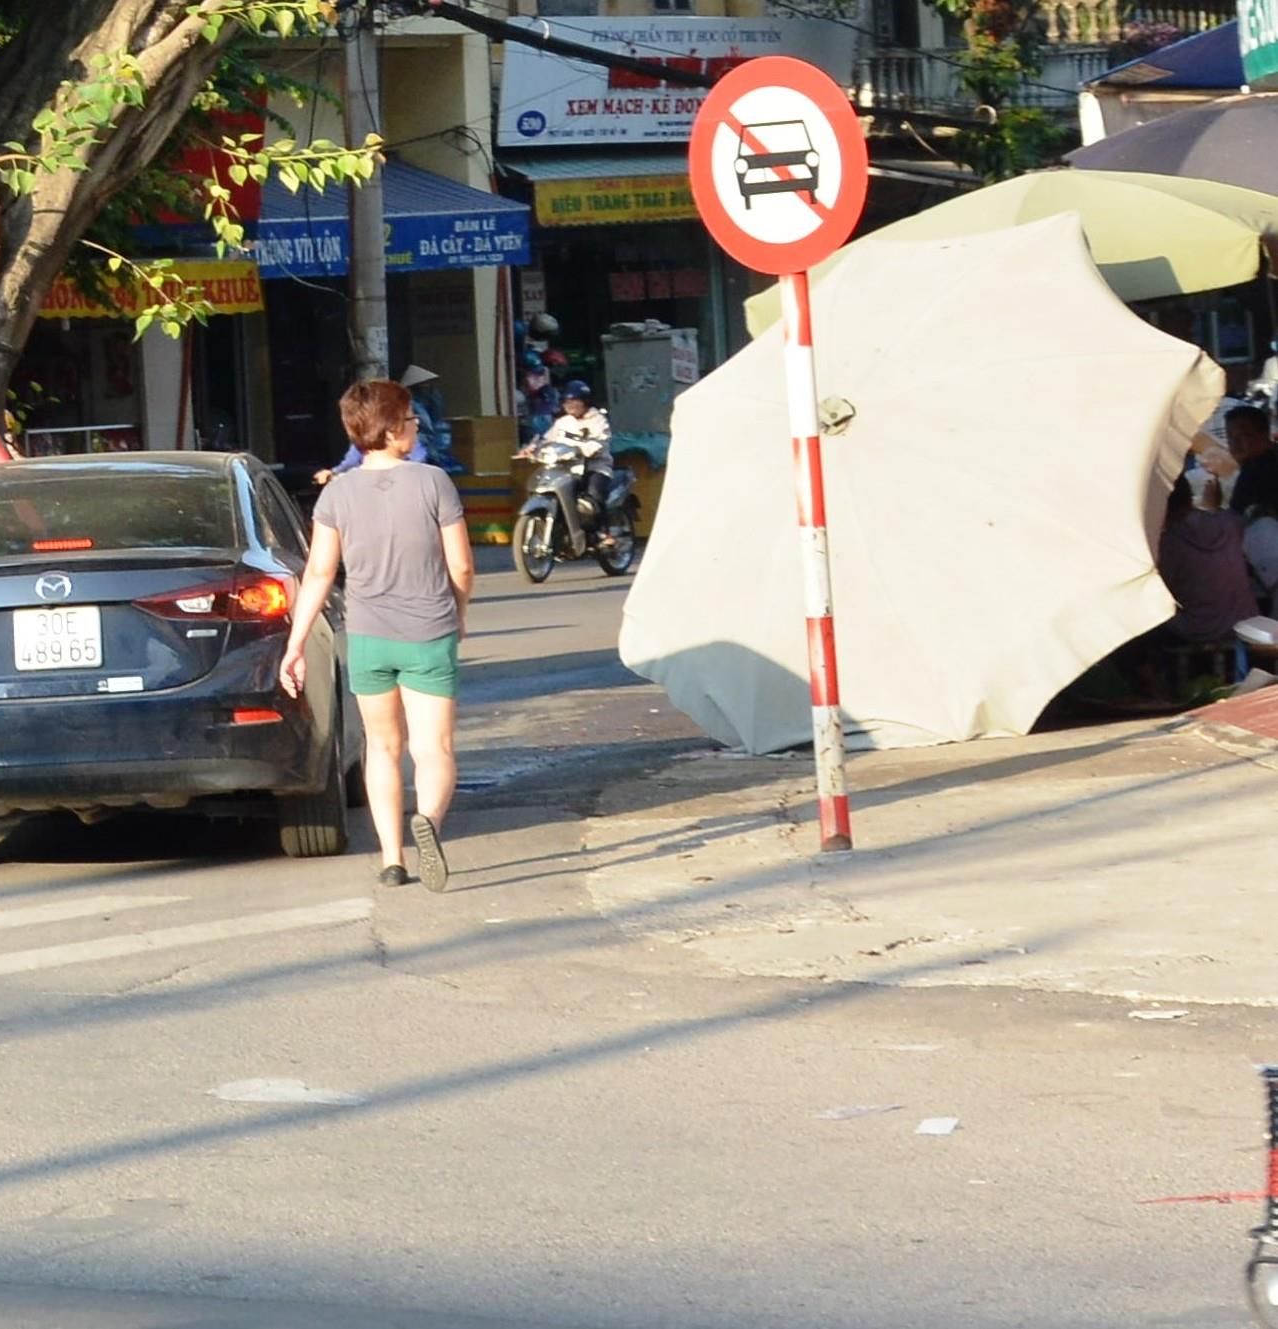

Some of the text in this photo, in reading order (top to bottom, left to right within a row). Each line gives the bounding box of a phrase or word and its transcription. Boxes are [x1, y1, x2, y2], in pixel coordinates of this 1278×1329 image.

[686, 30, 695, 42] Y
[566, 99, 596, 116] XEM
[603, 98, 643, 118] MẠCH
[36, 611, 78, 637] 30E
